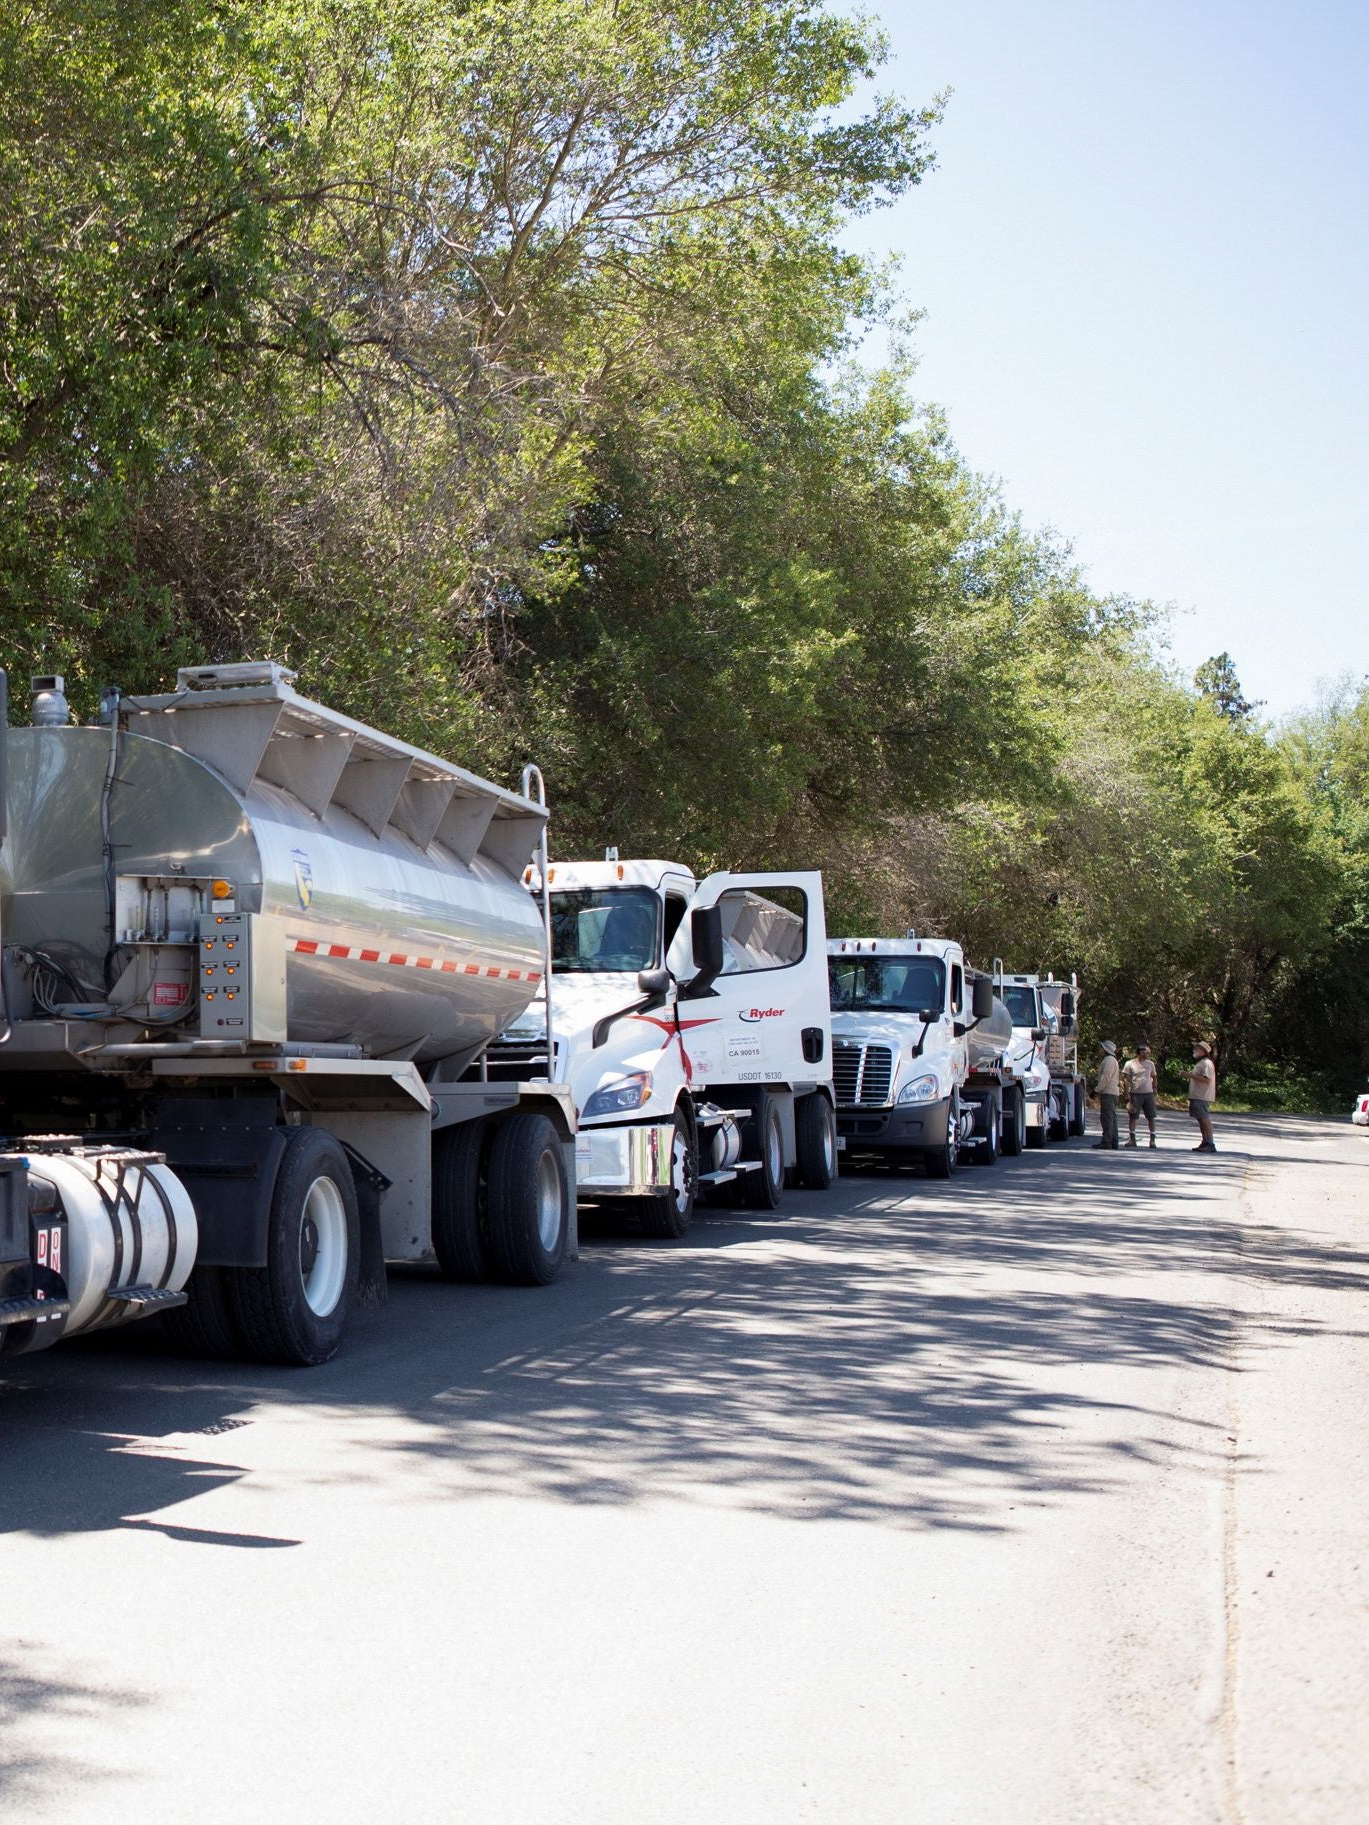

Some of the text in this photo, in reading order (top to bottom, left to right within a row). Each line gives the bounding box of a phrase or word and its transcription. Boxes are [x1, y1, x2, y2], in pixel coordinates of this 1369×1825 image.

[749, 1008, 785, 1019] Ryder
[738, 1072, 782, 1081] USDOT 16130
